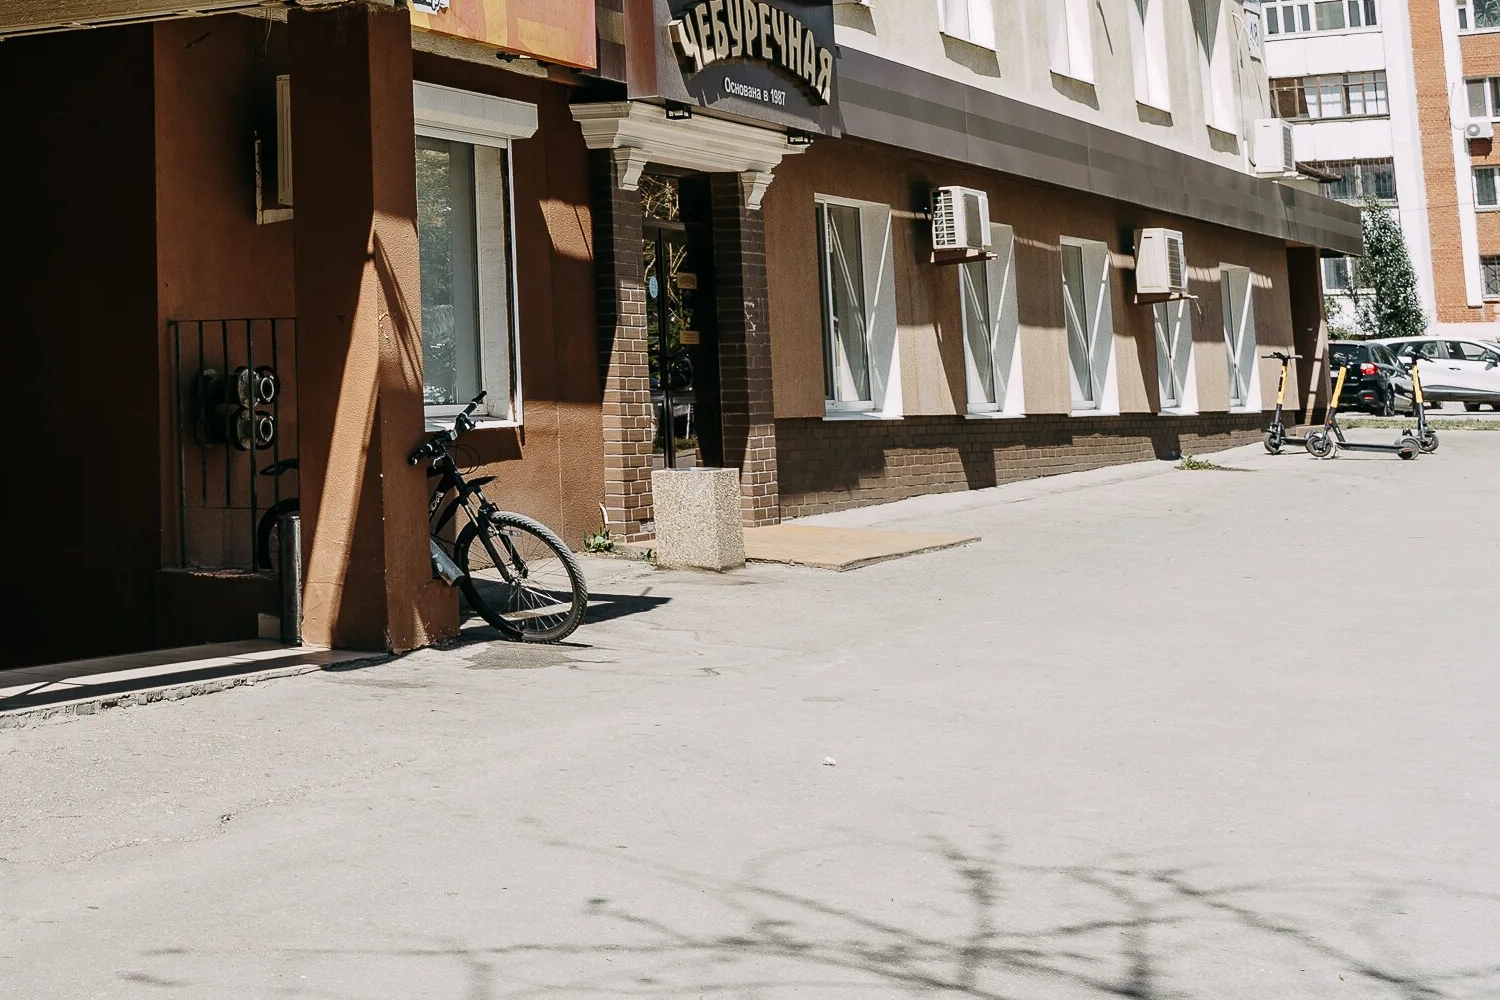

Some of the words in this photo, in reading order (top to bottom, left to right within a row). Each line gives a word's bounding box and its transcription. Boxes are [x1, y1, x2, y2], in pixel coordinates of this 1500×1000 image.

[724, 76, 762, 100] Основана
[763, 90, 769, 102] в
[770, 88, 786, 106] 1987
